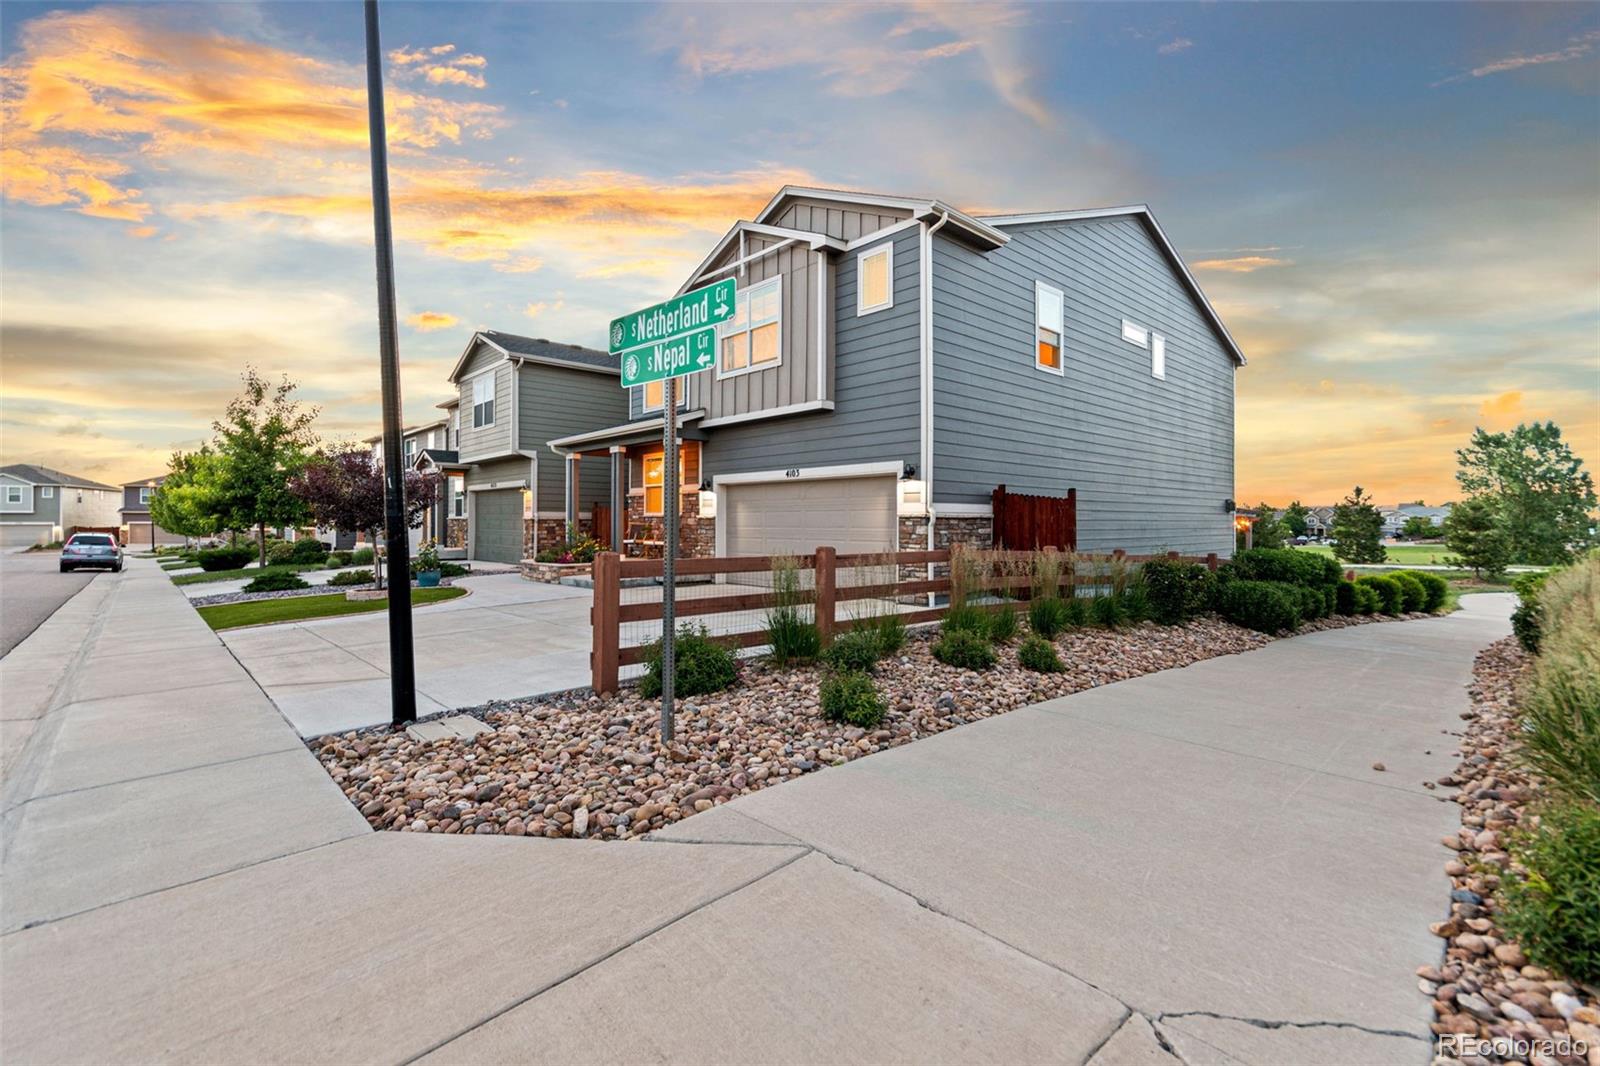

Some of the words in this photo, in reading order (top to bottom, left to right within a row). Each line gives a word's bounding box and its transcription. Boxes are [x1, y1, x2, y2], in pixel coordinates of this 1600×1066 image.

[631, 322, 637, 337] S
[637, 293, 708, 341] Netherland
[715, 286, 728, 303] Cir
[647, 356, 653, 371] S
[654, 338, 690, 375] Nepal
[697, 333, 709, 349] Cir
